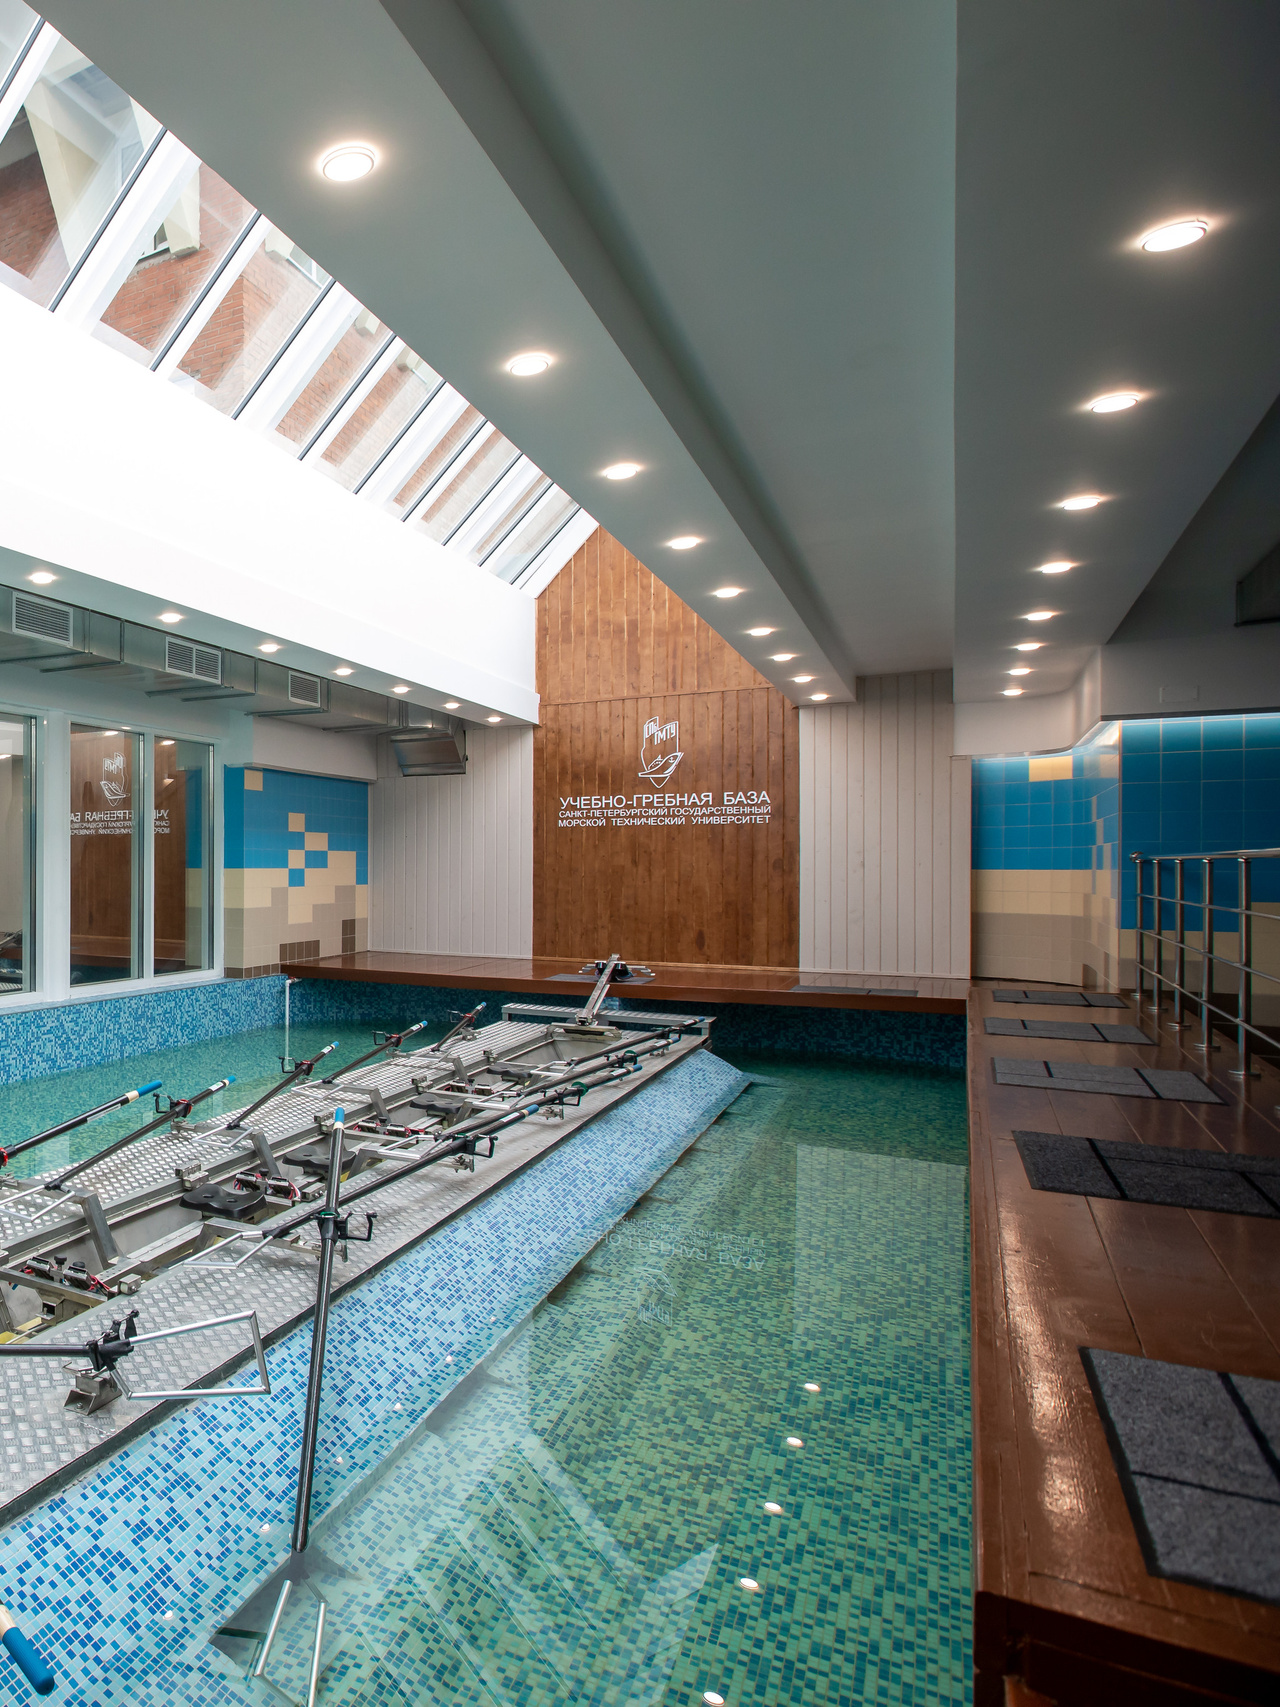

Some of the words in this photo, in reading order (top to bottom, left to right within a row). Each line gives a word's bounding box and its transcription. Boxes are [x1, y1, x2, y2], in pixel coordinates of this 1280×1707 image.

[560, 792, 712, 809] УЧЕБНО-ГРЕБНАЯ
[723, 791, 771, 805] БАЗА
[558, 807, 668, 818] САНКТ-ПЕТЕРБУРГСКИЙ
[669, 805, 771, 816] ГОСУДАРСТВЕННЫЙ
[558, 817, 606, 827] МОРСКОЙ
[610, 816, 685, 826] ТЕХНИЧЕСКИЙ
[692, 815, 771, 825] УНИВЕРСИТЕТ
